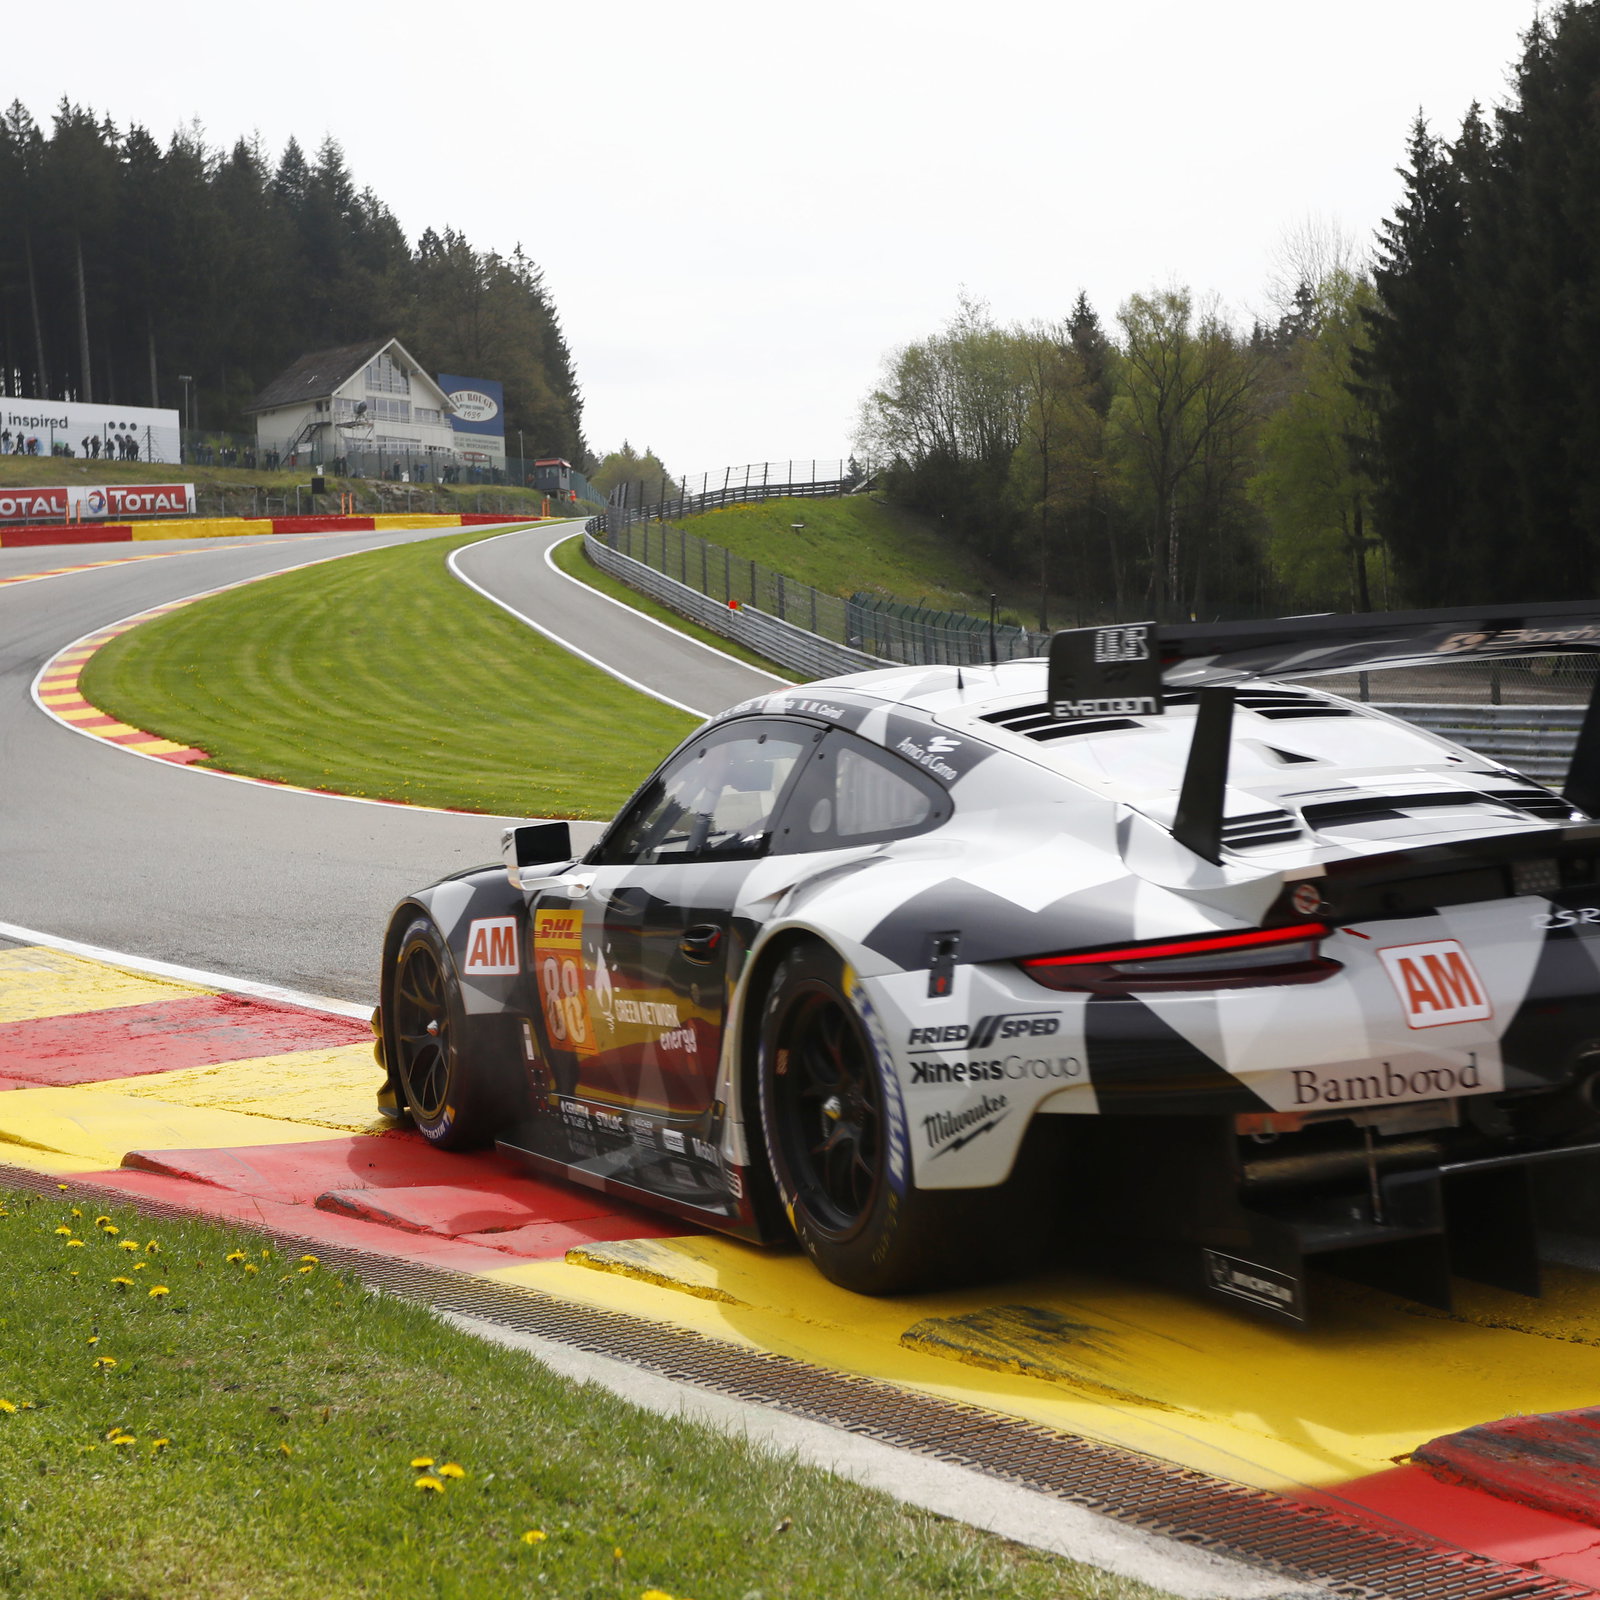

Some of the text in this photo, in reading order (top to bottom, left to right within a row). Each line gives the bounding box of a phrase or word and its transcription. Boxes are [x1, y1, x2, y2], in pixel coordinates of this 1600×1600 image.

[8, 412, 68, 430] inspired
[110, 490, 184, 512] TOTAL
[540, 918, 575, 939] DHL
[1530, 908, 1600, 930] RSR
[468, 925, 516, 967] AM
[1397, 951, 1483, 1015] AM
[543, 957, 587, 1044] 88
[660, 1027, 697, 1054] energy
[908, 1017, 1061, 1046] FRIED SPED
